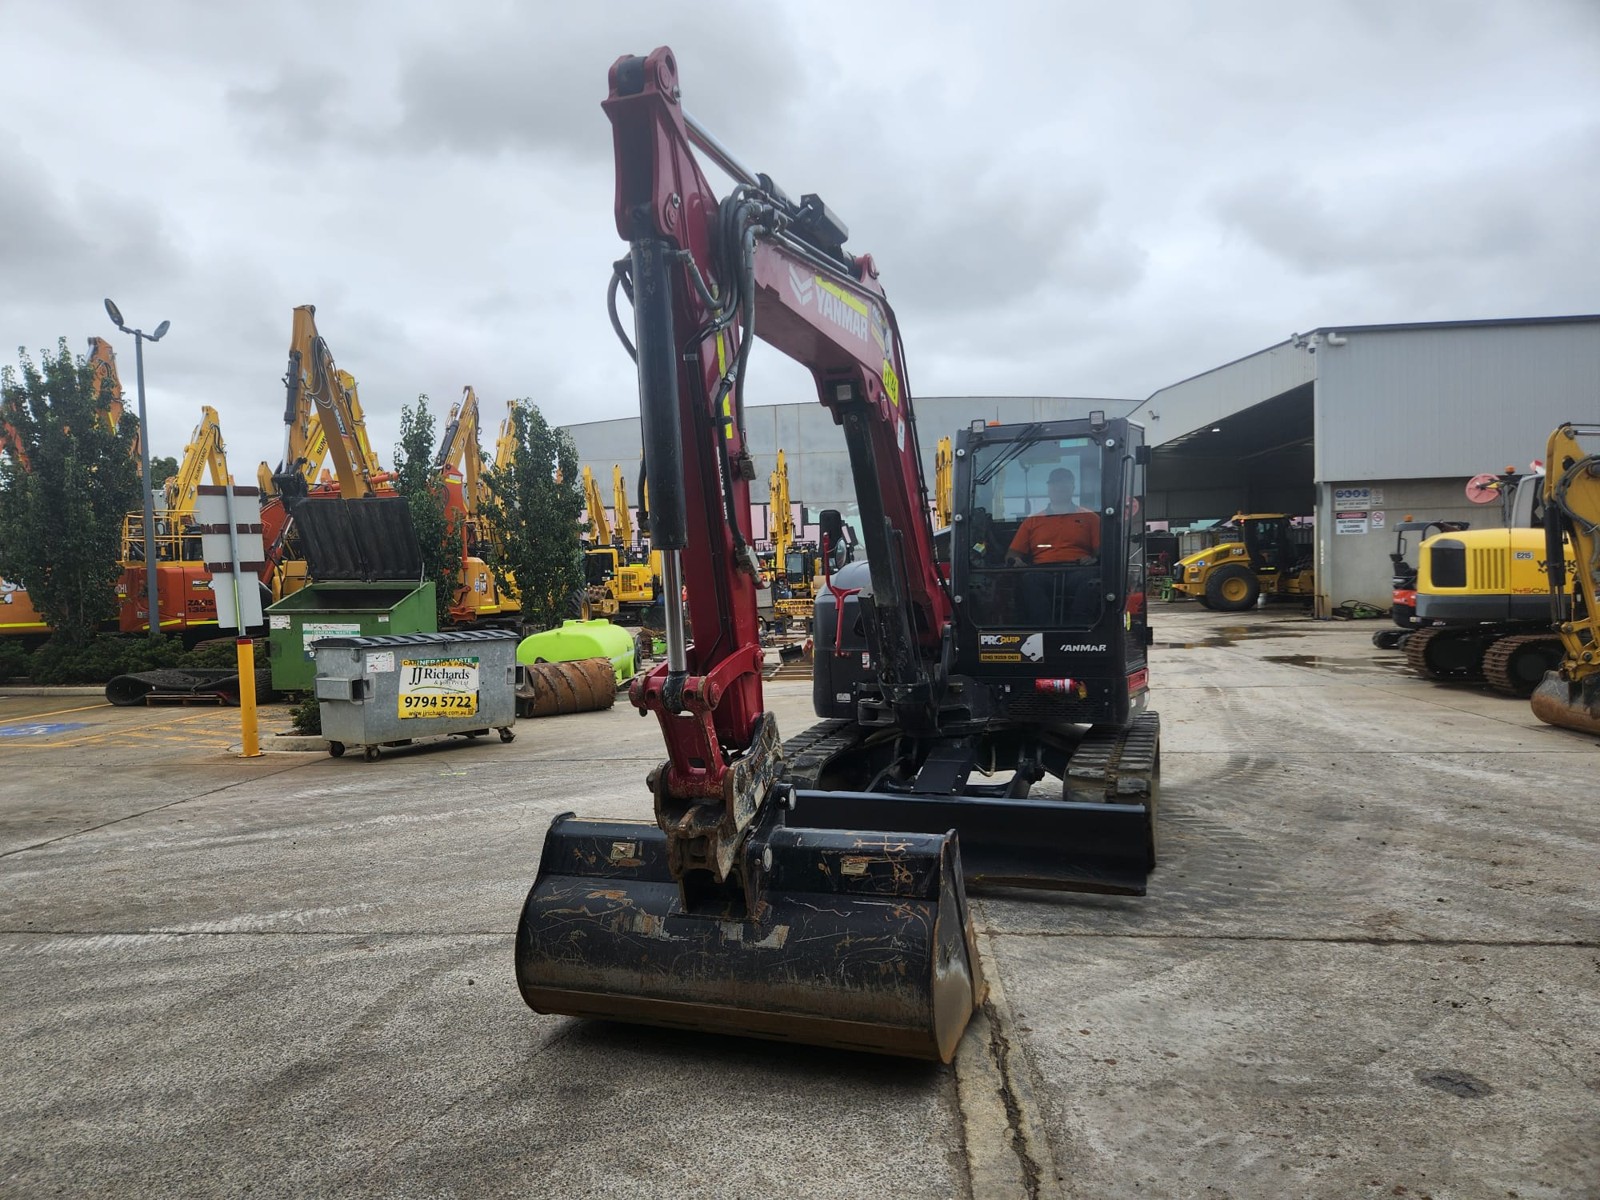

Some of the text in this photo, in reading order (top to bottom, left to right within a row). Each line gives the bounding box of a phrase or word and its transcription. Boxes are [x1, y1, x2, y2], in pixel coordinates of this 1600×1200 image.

[815, 284, 868, 341] YANMAR
[1060, 644, 1107, 652] YANMAR
[424, 668, 470, 680] Richards
[404, 696, 472, 708] 9794 5722
